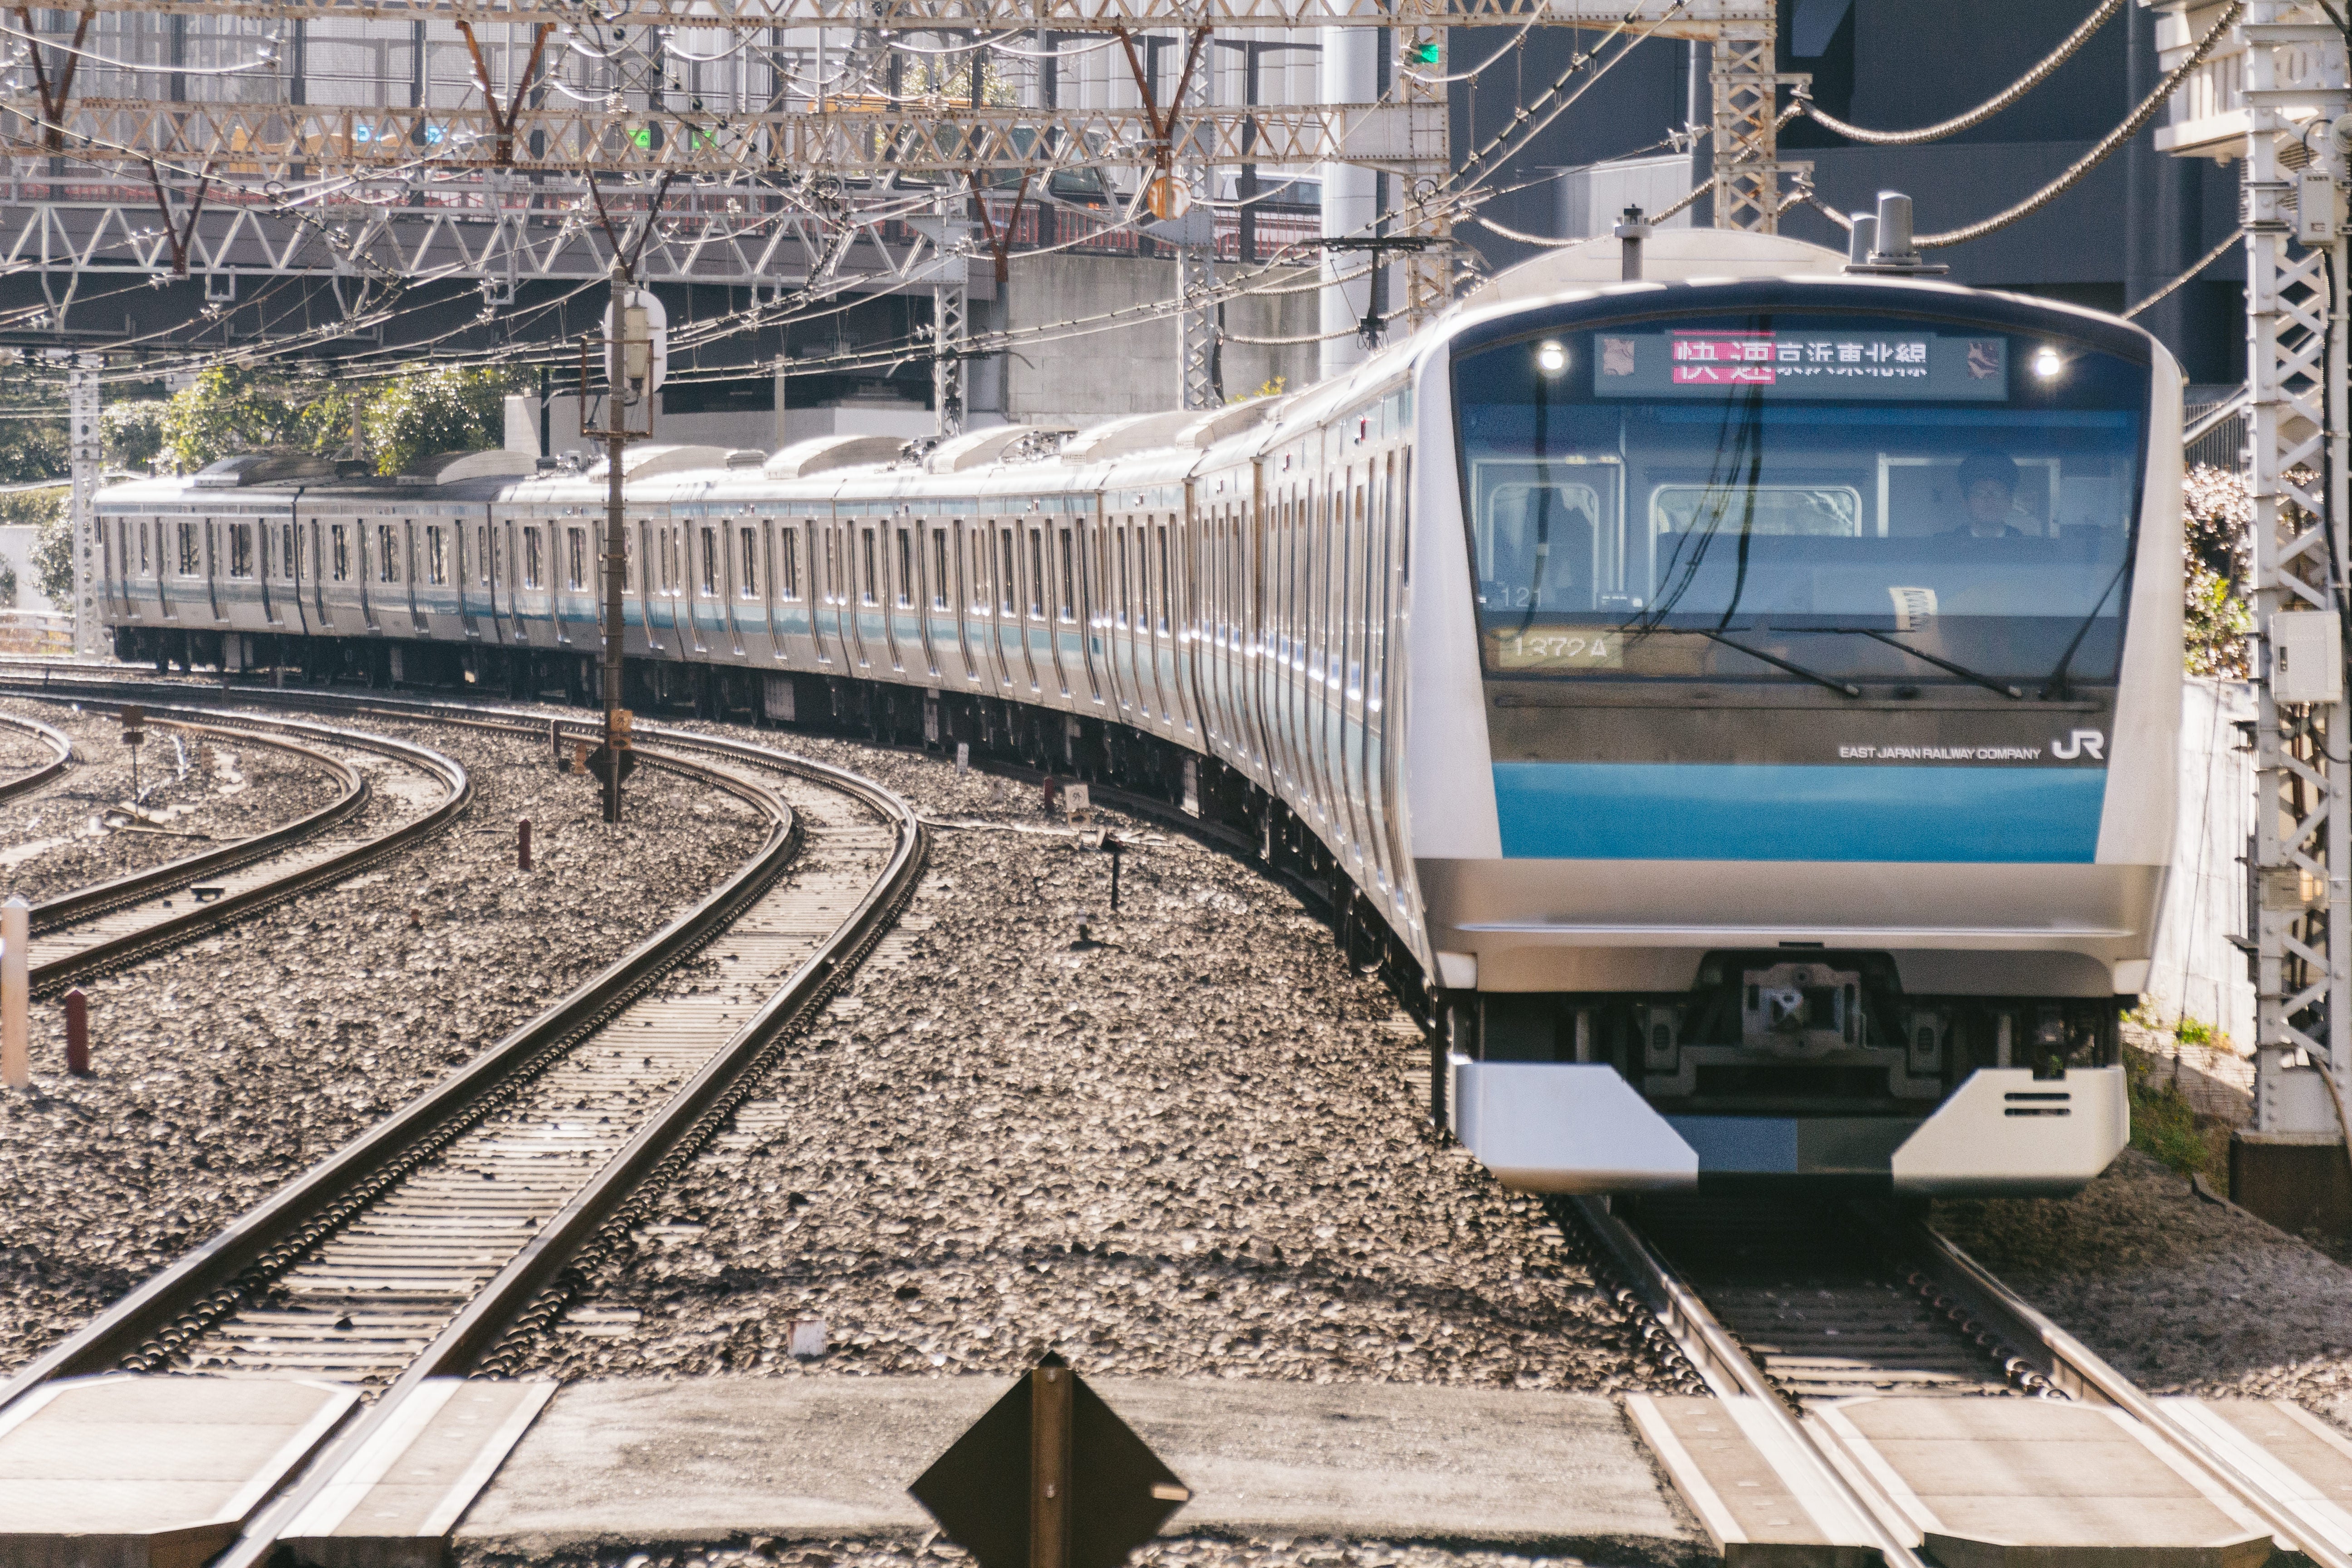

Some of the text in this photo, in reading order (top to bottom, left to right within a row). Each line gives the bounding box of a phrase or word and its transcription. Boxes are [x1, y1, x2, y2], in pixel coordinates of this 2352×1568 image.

[1840, 746, 2042, 760] EAST JAPAN RAILWAY COMPANY
[2052, 730, 2104, 760] JR
